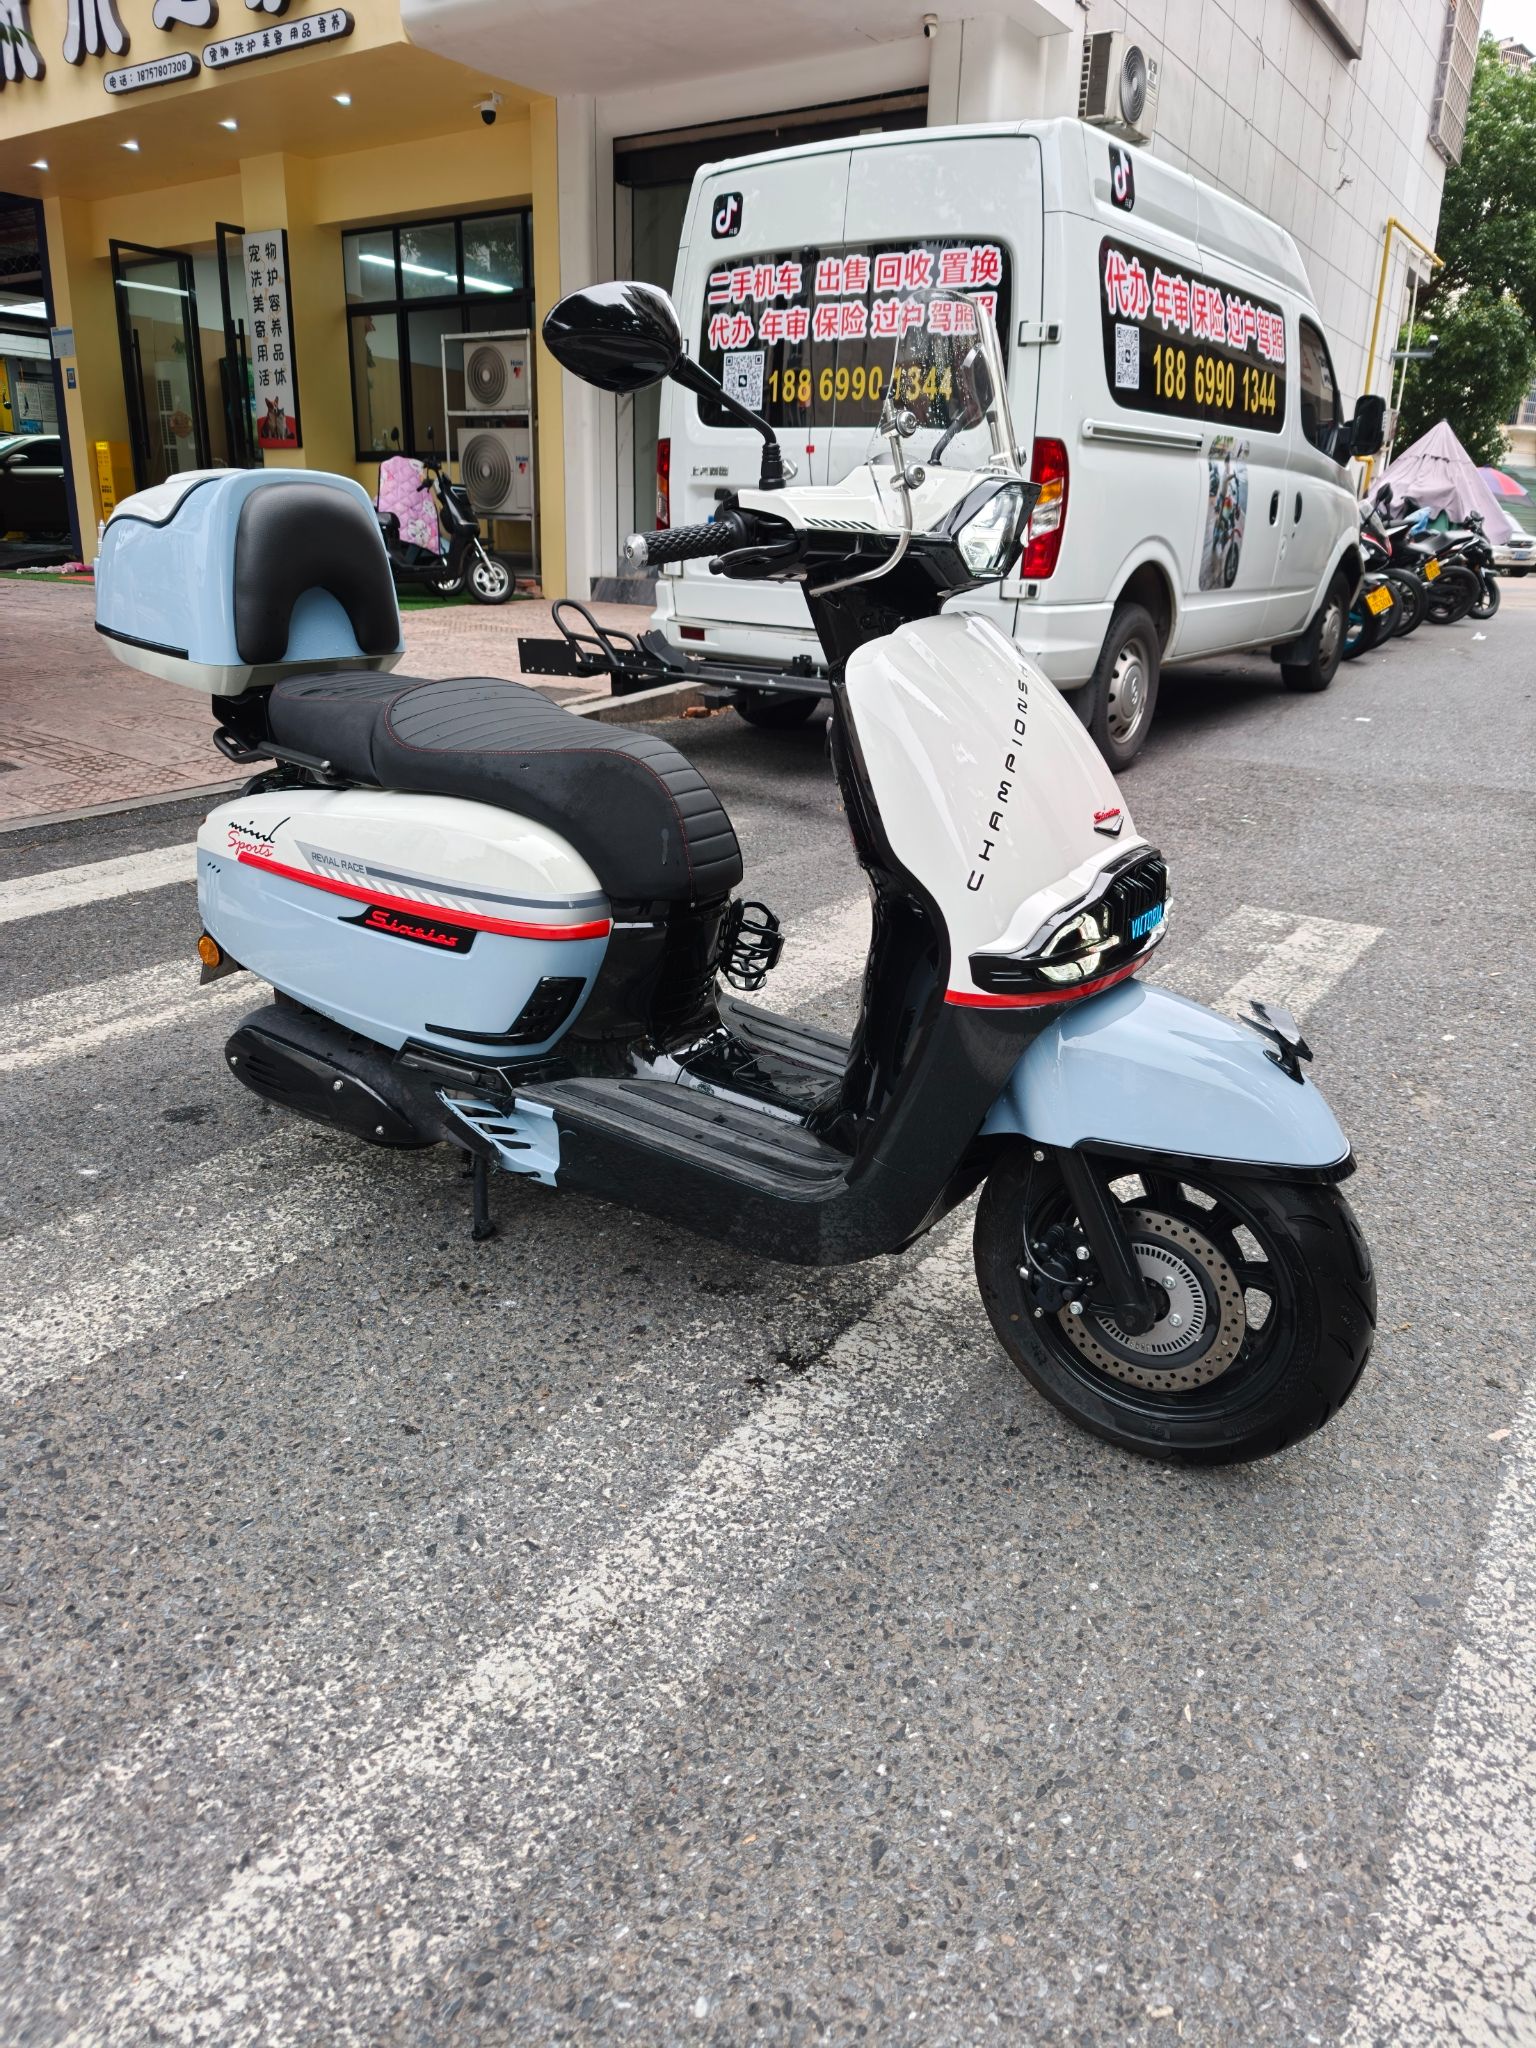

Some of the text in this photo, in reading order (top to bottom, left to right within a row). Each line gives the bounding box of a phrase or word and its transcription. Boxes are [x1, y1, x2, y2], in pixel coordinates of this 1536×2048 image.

[262, 30, 282, 48] 美容
[290, 23, 311, 40] 用品
[709, 249, 1000, 301] 二手机车 出售 回收 置换
[709, 315, 753, 348] 代办
[760, 309, 808, 342] 年审
[814, 302, 864, 338] 保险
[873, 299, 924, 337] 过户
[1106, 251, 1284, 361] 代办 年审 保险 过户 驾照
[769, 366, 952, 402] 188 6990 1344
[1153, 344, 1275, 415] 188 6990 1344
[228, 830, 274, 857] Sports
[312, 852, 365, 874] REVIAL RACE
